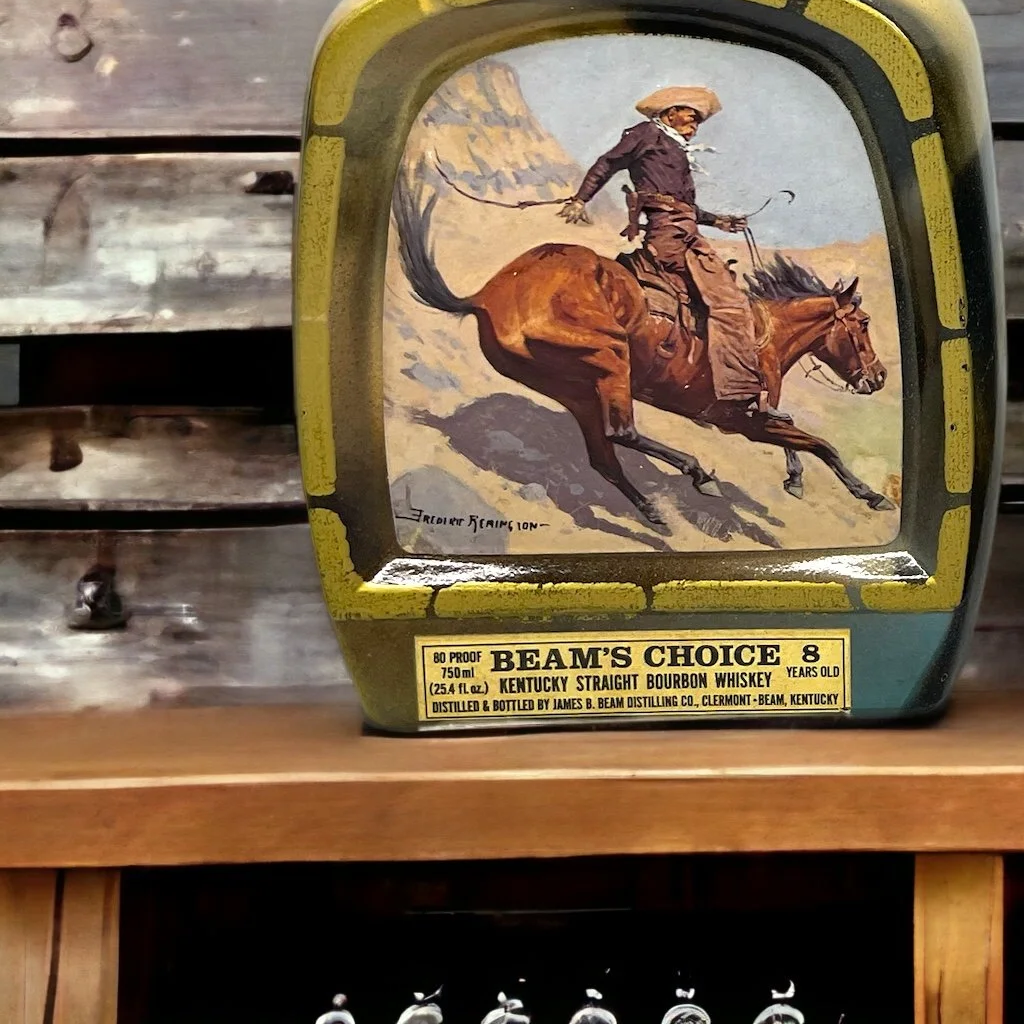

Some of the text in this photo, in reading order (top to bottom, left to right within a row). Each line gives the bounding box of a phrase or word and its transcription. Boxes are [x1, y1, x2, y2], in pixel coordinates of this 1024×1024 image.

[433, 651, 482, 664] 80 PROOF
[490, 644, 820, 672] BEAM'S CHOICE 8
[786, 666, 840, 678] YEARS OLD
[430, 682, 455, 696] (25.4
[500, 672, 772, 694] KENTUCKY STRAIGHT BOURBON WHISKEY
[432, 700, 480, 712] DISTILLED
[482, 700, 490, 712] &
[492, 700, 534, 712] BOTTLED
[538, 699, 550, 710] BY
[552, 698, 582, 710] JAMES
[586, 698, 595, 709] B.
[598, 697, 624, 708] BEAM
[627, 696, 678, 708] DISTILLING
[790, 694, 839, 706] KENTUCKY
